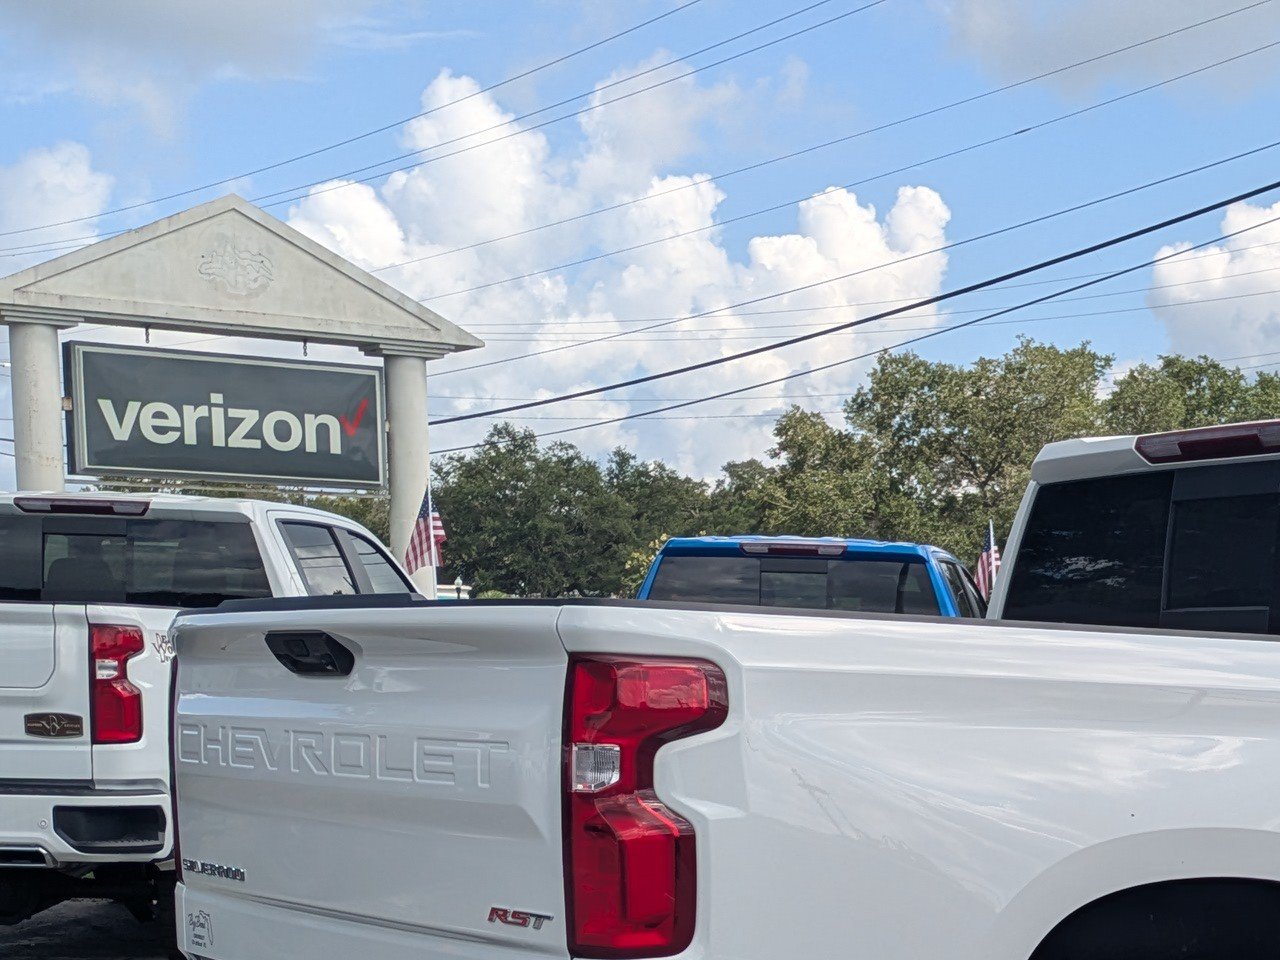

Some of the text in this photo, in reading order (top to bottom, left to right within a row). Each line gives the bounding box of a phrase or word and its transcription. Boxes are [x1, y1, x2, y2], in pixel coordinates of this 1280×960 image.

[97, 393, 342, 455] verizon
[178, 723, 510, 789] CHEVROLET
[487, 906, 554, 930] RST
